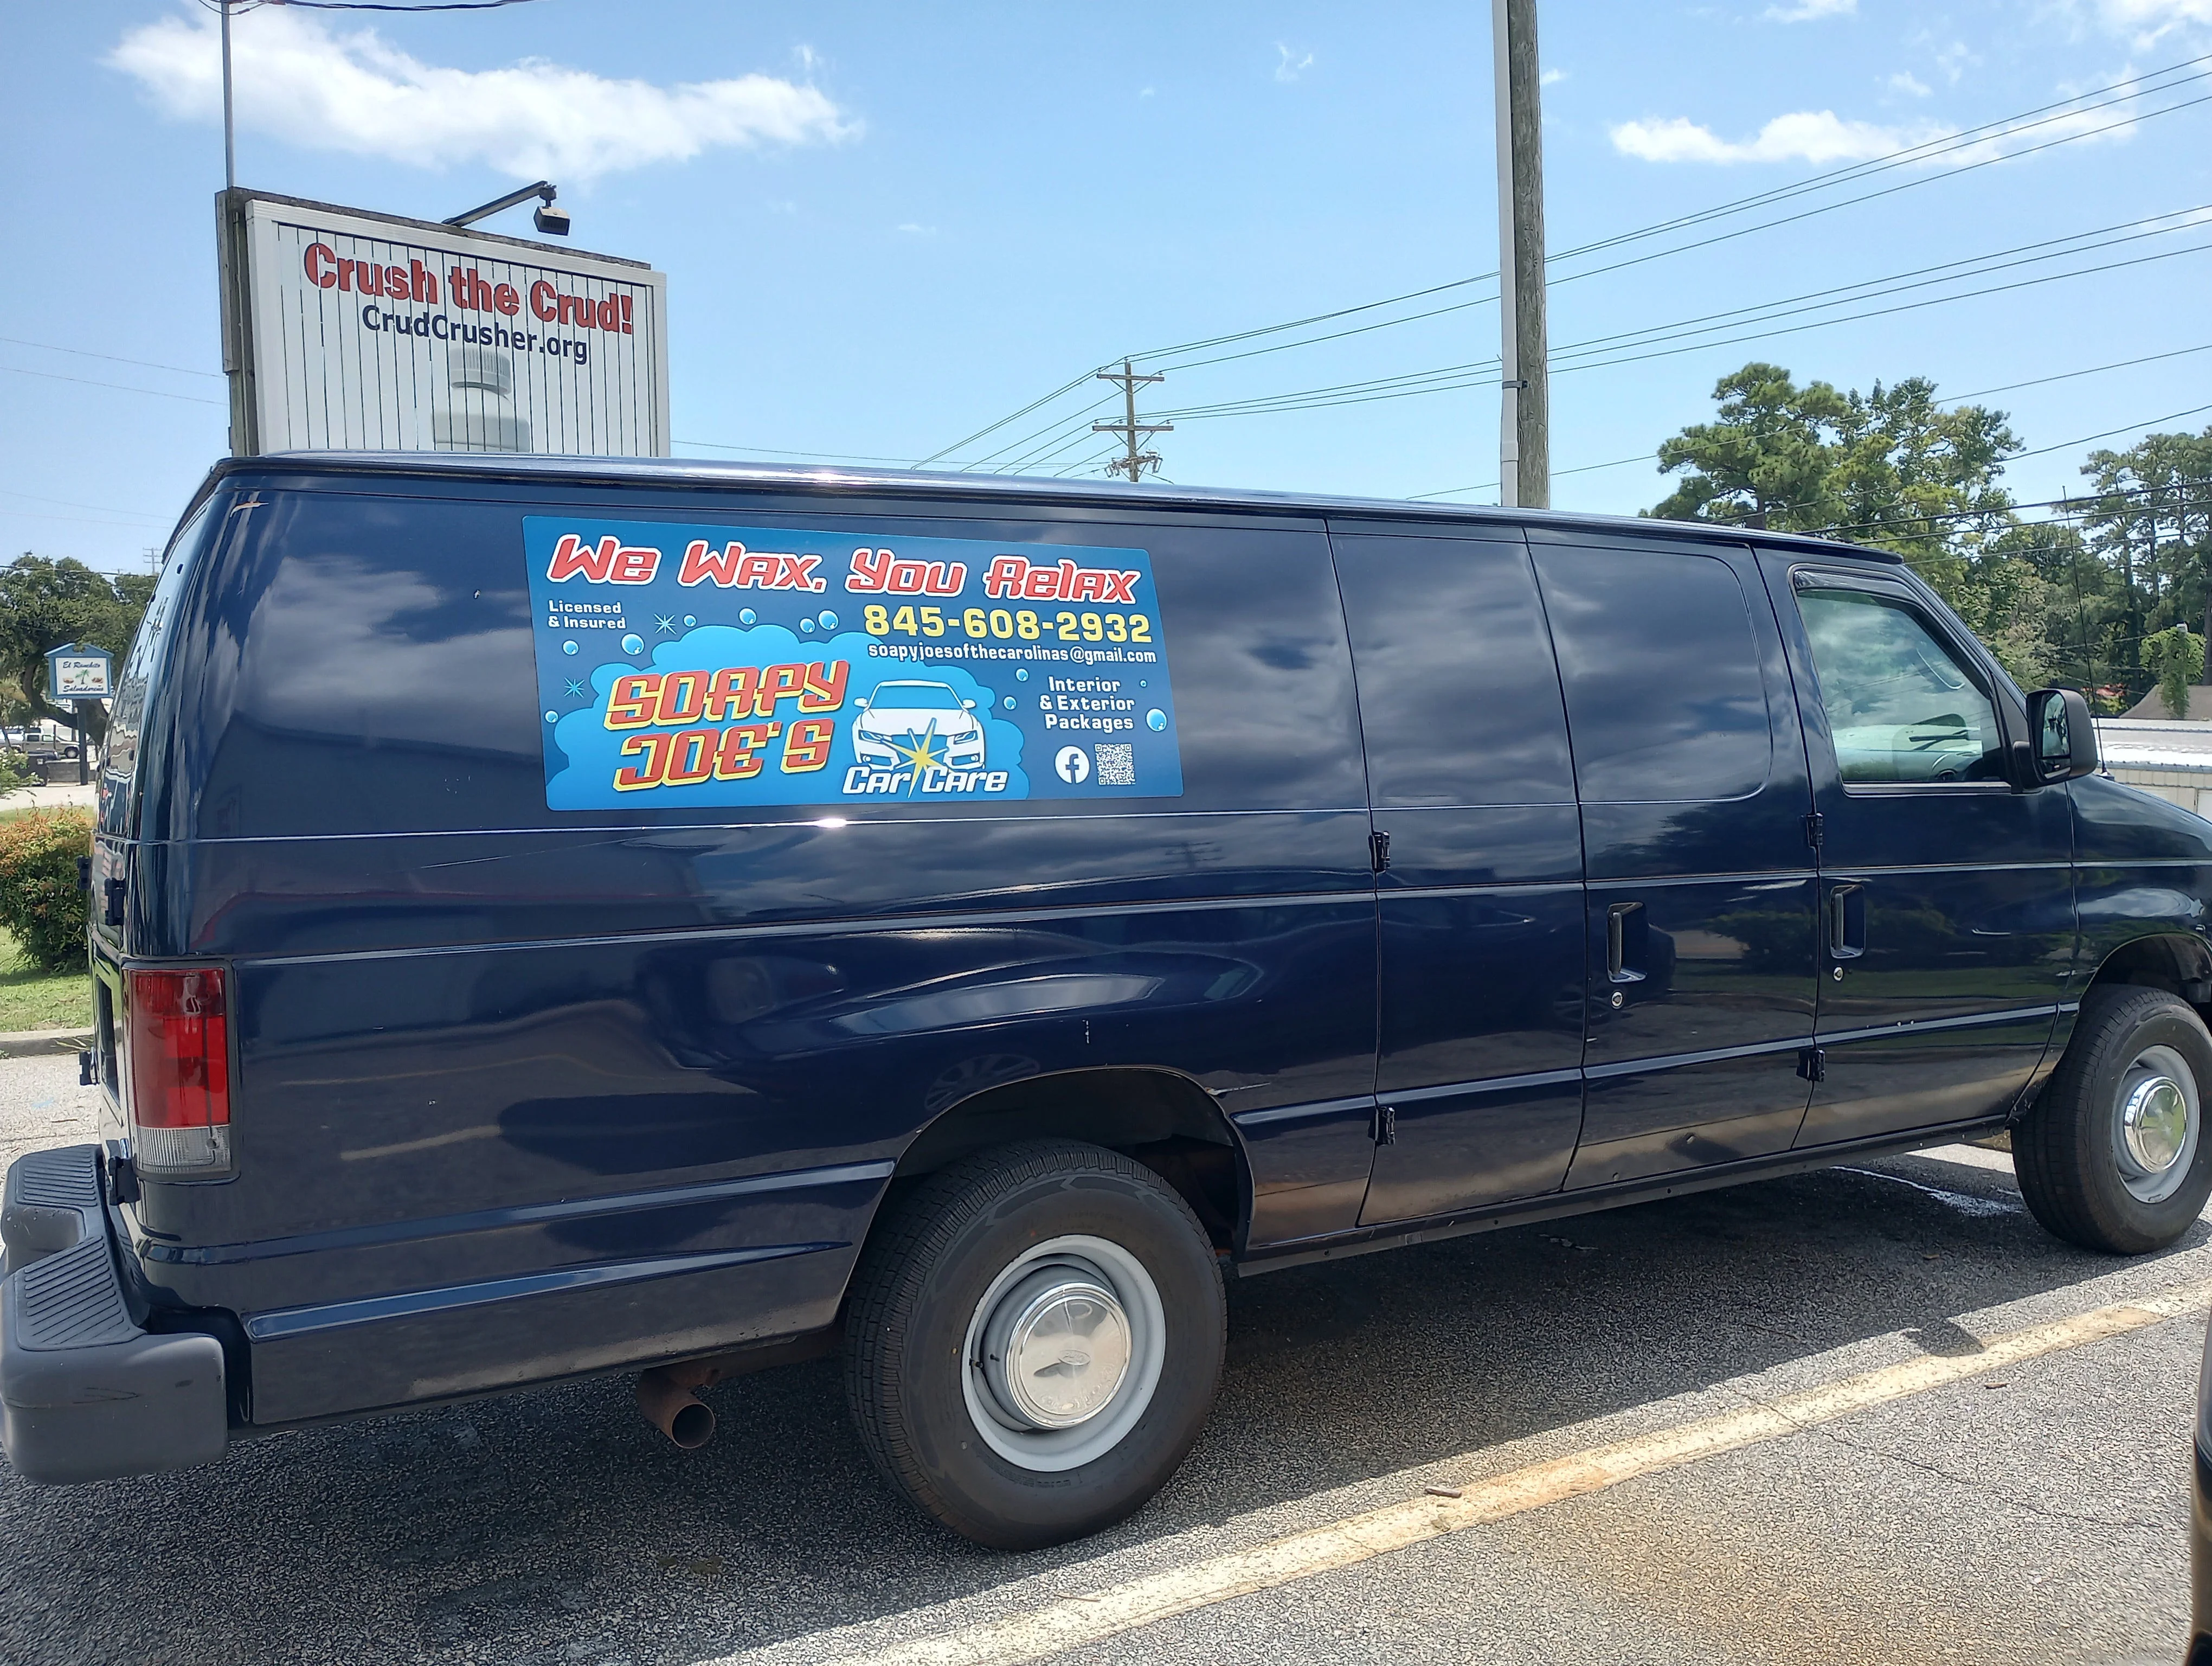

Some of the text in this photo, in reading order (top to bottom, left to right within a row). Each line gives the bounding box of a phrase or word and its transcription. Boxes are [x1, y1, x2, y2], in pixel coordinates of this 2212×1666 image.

[304, 242, 632, 334] Crush the Crud!
[363, 305, 587, 365] CrudCrusher.org
[546, 534, 662, 585] We
[845, 548, 967, 597] You
[982, 555, 1141, 604] Relax
[549, 600, 622, 614] Licensed
[548, 616, 626, 629] & Insured
[864, 605, 1153, 643] 845-608-2932
[868, 643, 1157, 665] soapyjoesofthecarolinas@gmail.com
[603, 660, 850, 731] SOAPY
[1049, 676, 1121, 692] Interior
[1040, 695, 1135, 710] & Exterior
[1045, 714, 1134, 733] Packages
[612, 718, 834, 791] JOE'S
[842, 766, 1008, 794] Car Care
